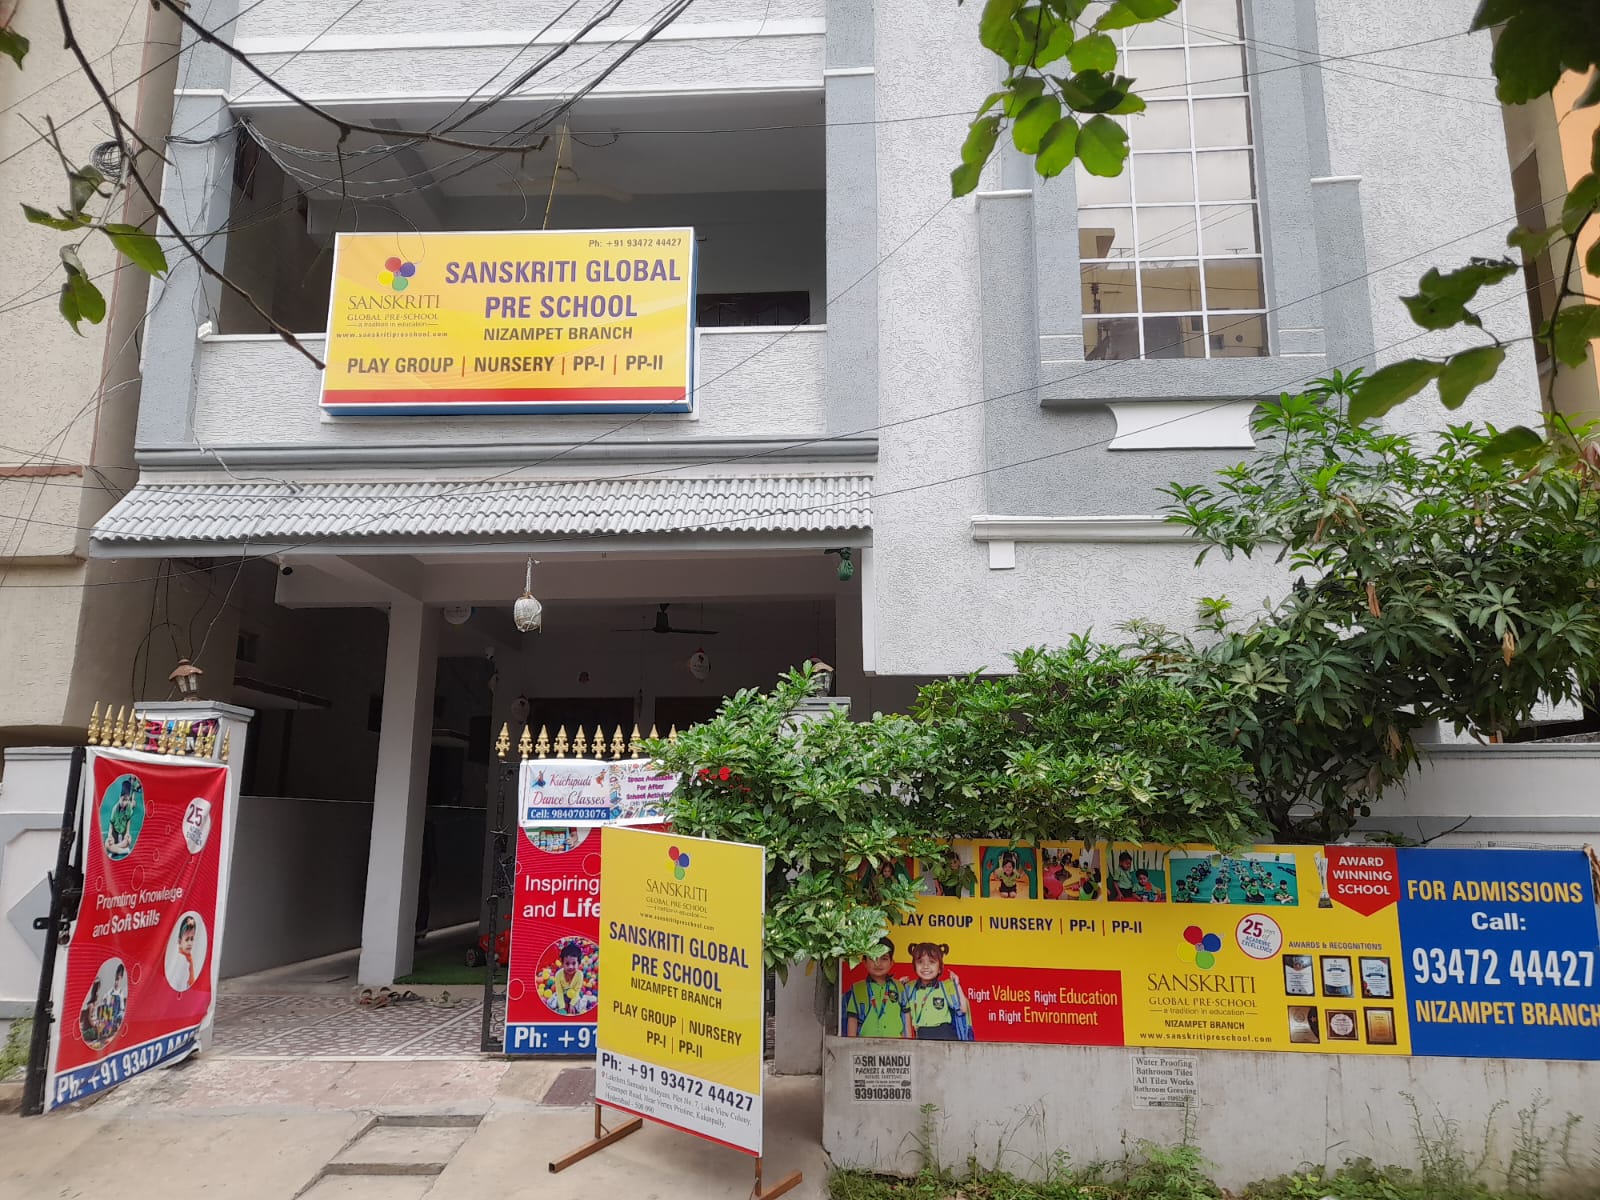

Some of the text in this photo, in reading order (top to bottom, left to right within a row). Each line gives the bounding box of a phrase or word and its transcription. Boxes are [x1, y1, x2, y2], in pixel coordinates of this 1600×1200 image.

[588, 237, 682, 248] Ph: +91 93472 44427
[445, 258, 681, 284] SANSKRITI GLOBAL
[347, 294, 440, 310] SANSKRITI
[485, 294, 638, 319] PRE SCHOOL
[346, 313, 382, 321] GLOBAL
[484, 326, 633, 341] NIZAMPET BRANCH
[347, 354, 664, 373] PLAY GROUP NURSERY PP-I PP-II
[549, 774, 593, 790] Kuchipudi
[533, 790, 607, 806] Dance Classes
[186, 803, 203, 827] 25
[530, 808, 608, 819] Cell: 9840703076
[1338, 856, 1384, 867] AWARD
[525, 874, 600, 896] Inspiring
[1332, 869, 1393, 881] WINNING
[646, 878, 708, 902] SANSKRITI
[1337, 883, 1391, 895] SCHOOL
[1407, 879, 1583, 904] FOR ADMISSIONS
[522, 900, 557, 918] and
[645, 896, 669, 906] GLOBAL
[92, 908, 160, 938] and Soft Skills
[899, 913, 1143, 934] LAY GROUP NURSERY PP-I PP-II
[1242, 918, 1263, 938] 25
[1471, 911, 1527, 931] Call:
[609, 921, 750, 969] SANSKRITI GLOBAL
[1288, 941, 1320, 949] AWARDS
[631, 953, 722, 992] PRE SCHOOL
[1412, 947, 1501, 985] 93472
[1509, 949, 1595, 988] 44427
[630, 977, 722, 1009] NIZAMPET BRANCH
[1147, 973, 1256, 994] SANSKRITI
[968, 985, 1118, 1006] Right Values Right Education
[1149, 996, 1257, 1008] GLOBAL PRE-SCHOOL
[613, 1000, 742, 1047] PLAY GROUP NURSERY
[988, 1006, 1099, 1026] in Right Environment
[1415, 999, 1600, 1028] NIZAMPET BRANCH
[1164, 1019, 1245, 1030] NIZAMPET BRANCH
[515, 1026, 548, 1049] Ph:
[646, 1031, 703, 1059] PP-I PP-II
[862, 1055, 911, 1067] SRI NANDU
[1136, 1057, 1193, 1069] Water Proofing
[1136, 1066, 1193, 1076] Bathroom Tiles
[56, 1074, 84, 1104] Ph:
[88, 1058, 118, 1090] +91
[601, 1052, 753, 1112] Ph: +91 93472 44427
[1135, 1076, 1194, 1086] All Tiles Works
[855, 1088, 911, 1100] 9391038078
